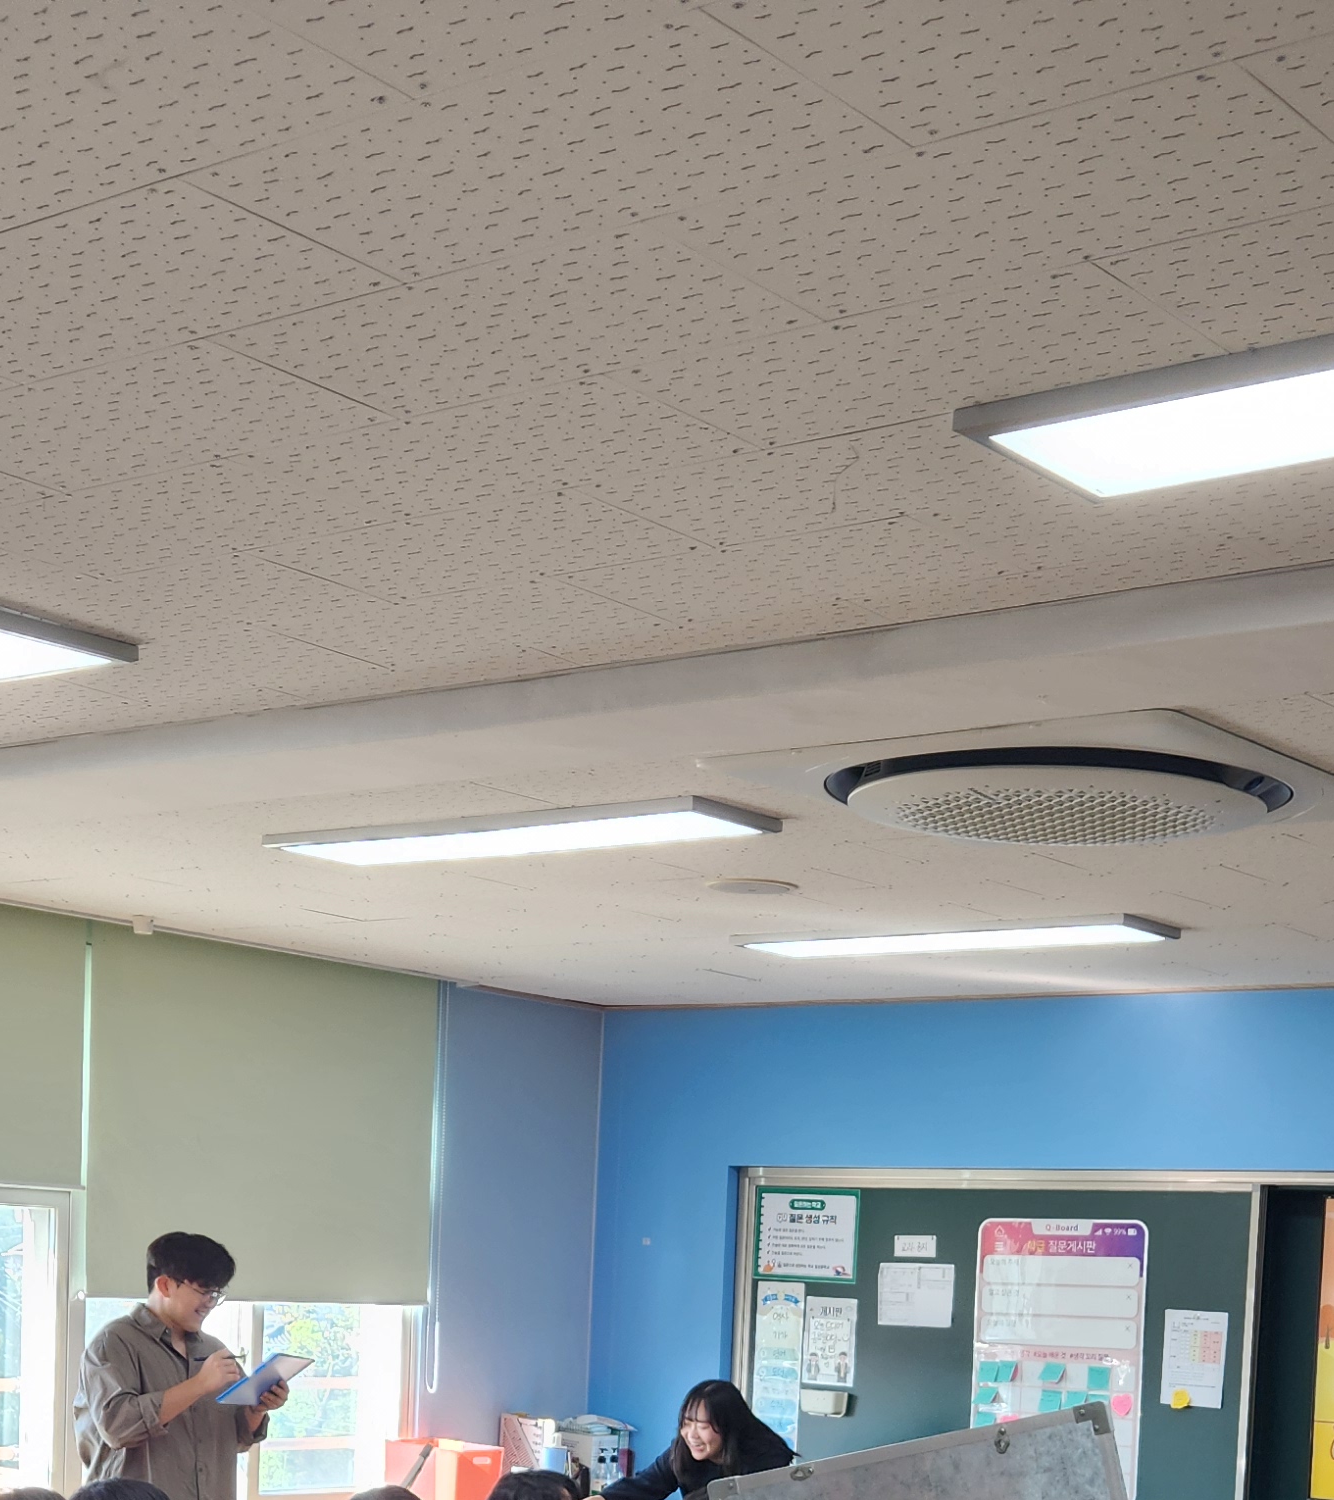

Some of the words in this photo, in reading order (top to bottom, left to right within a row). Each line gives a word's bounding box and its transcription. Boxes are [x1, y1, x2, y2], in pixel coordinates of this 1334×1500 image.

[805, 1213, 820, 1225] 생성
[1048, 1240, 1096, 1254] 질문게시판
[820, 1306, 843, 1317] 게시판
